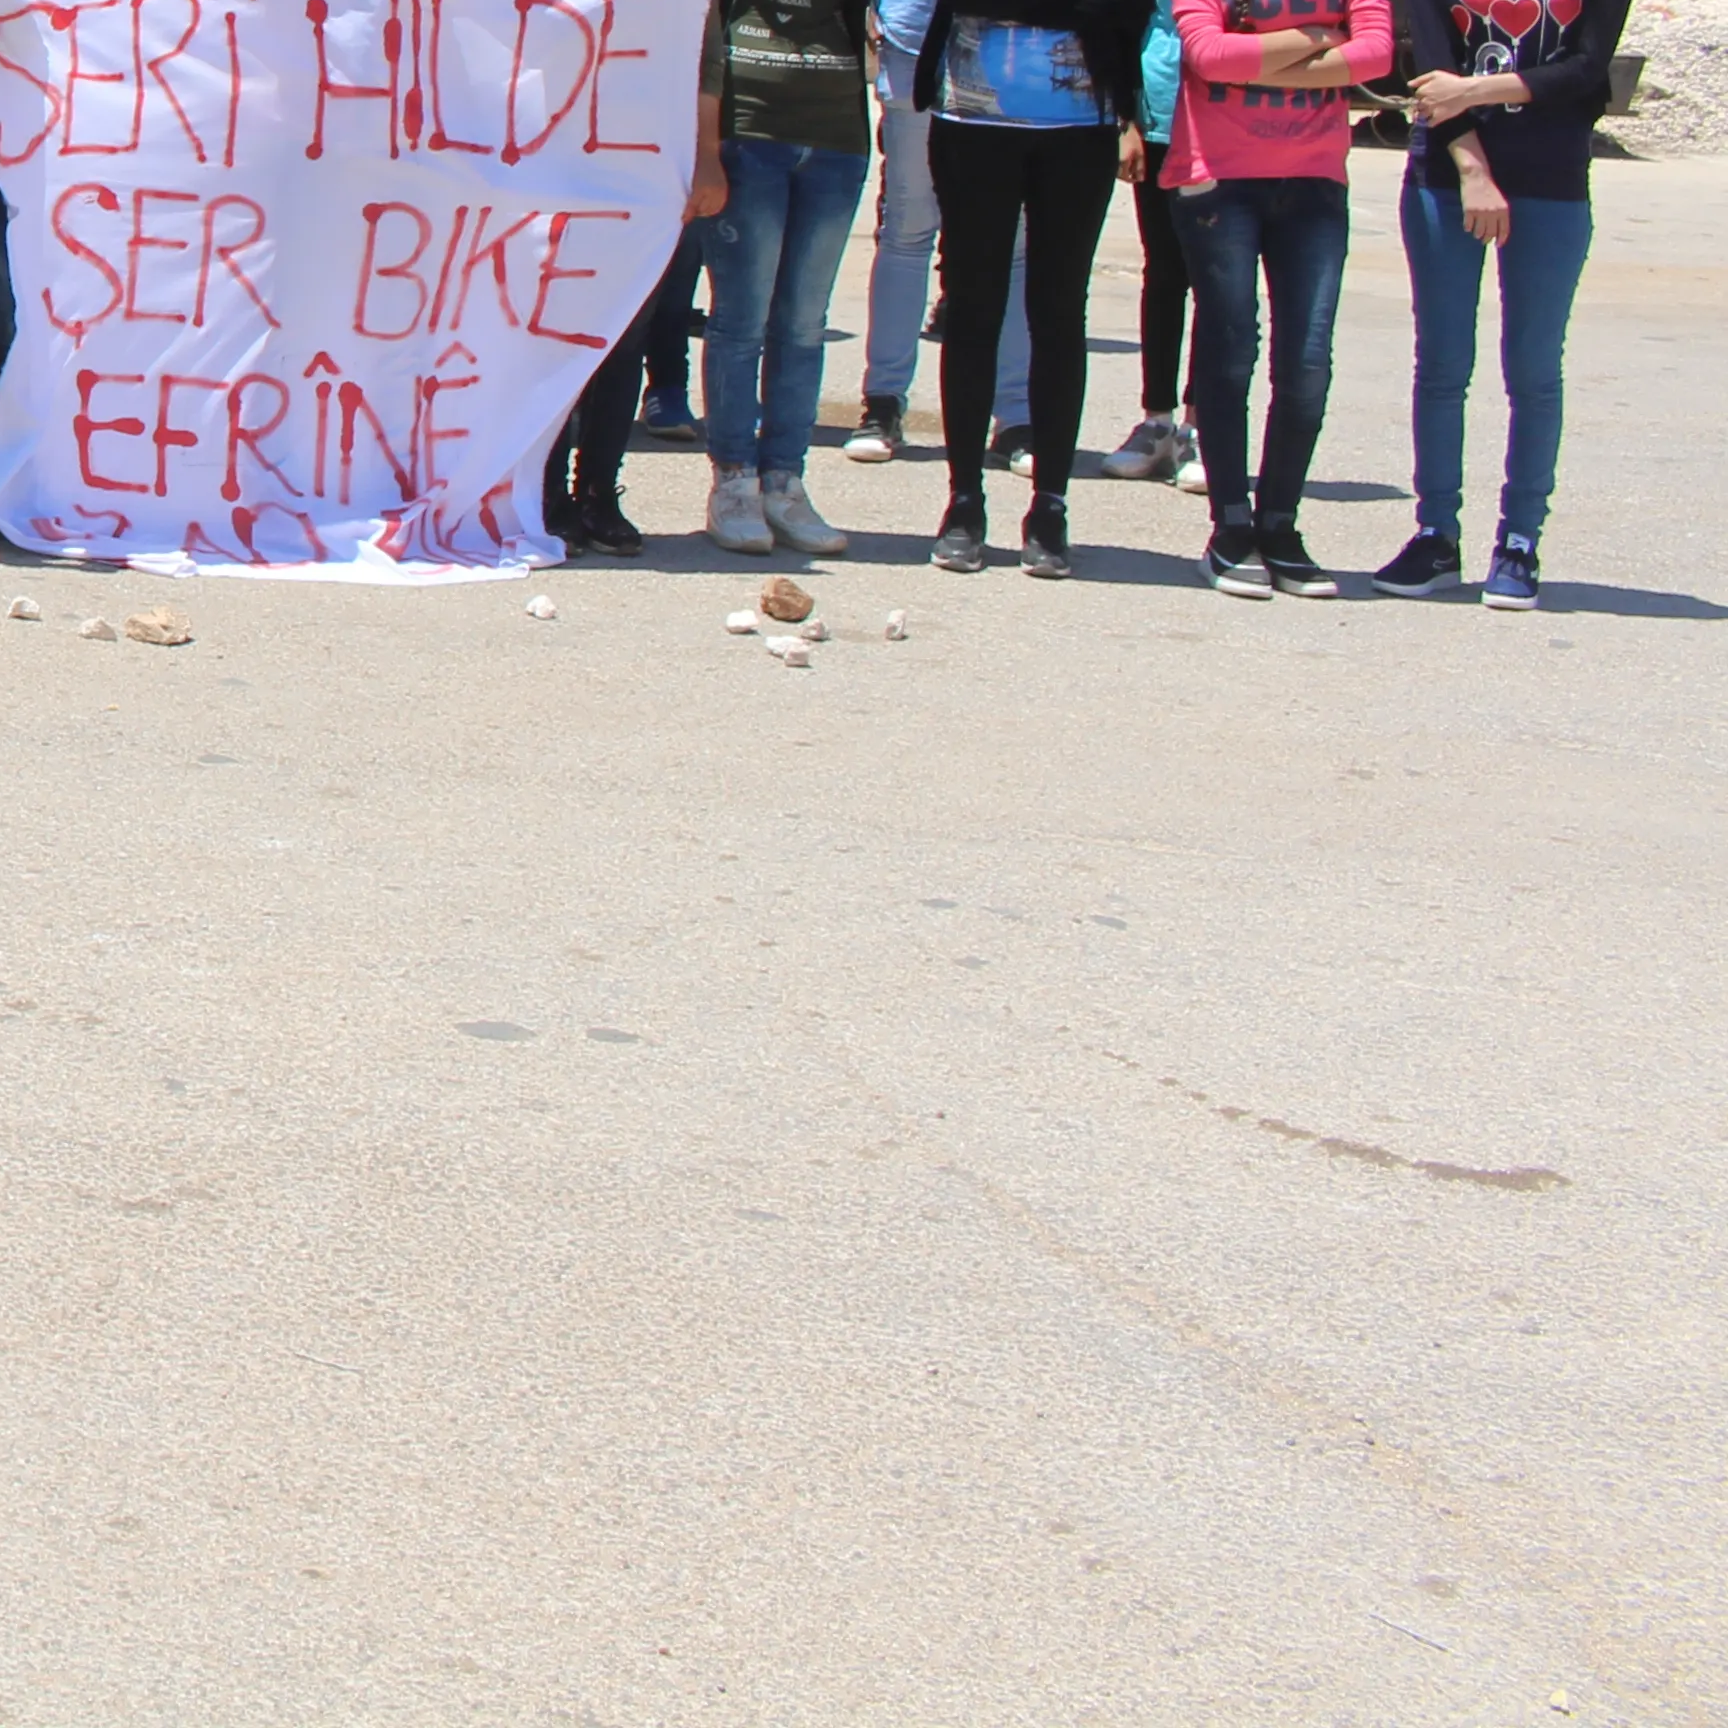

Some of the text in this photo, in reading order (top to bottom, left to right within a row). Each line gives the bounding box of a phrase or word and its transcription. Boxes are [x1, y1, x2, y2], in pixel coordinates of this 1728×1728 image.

[42, 183, 630, 350] ŞER BIKE
[74, 343, 480, 502] EFRÎNÊ
